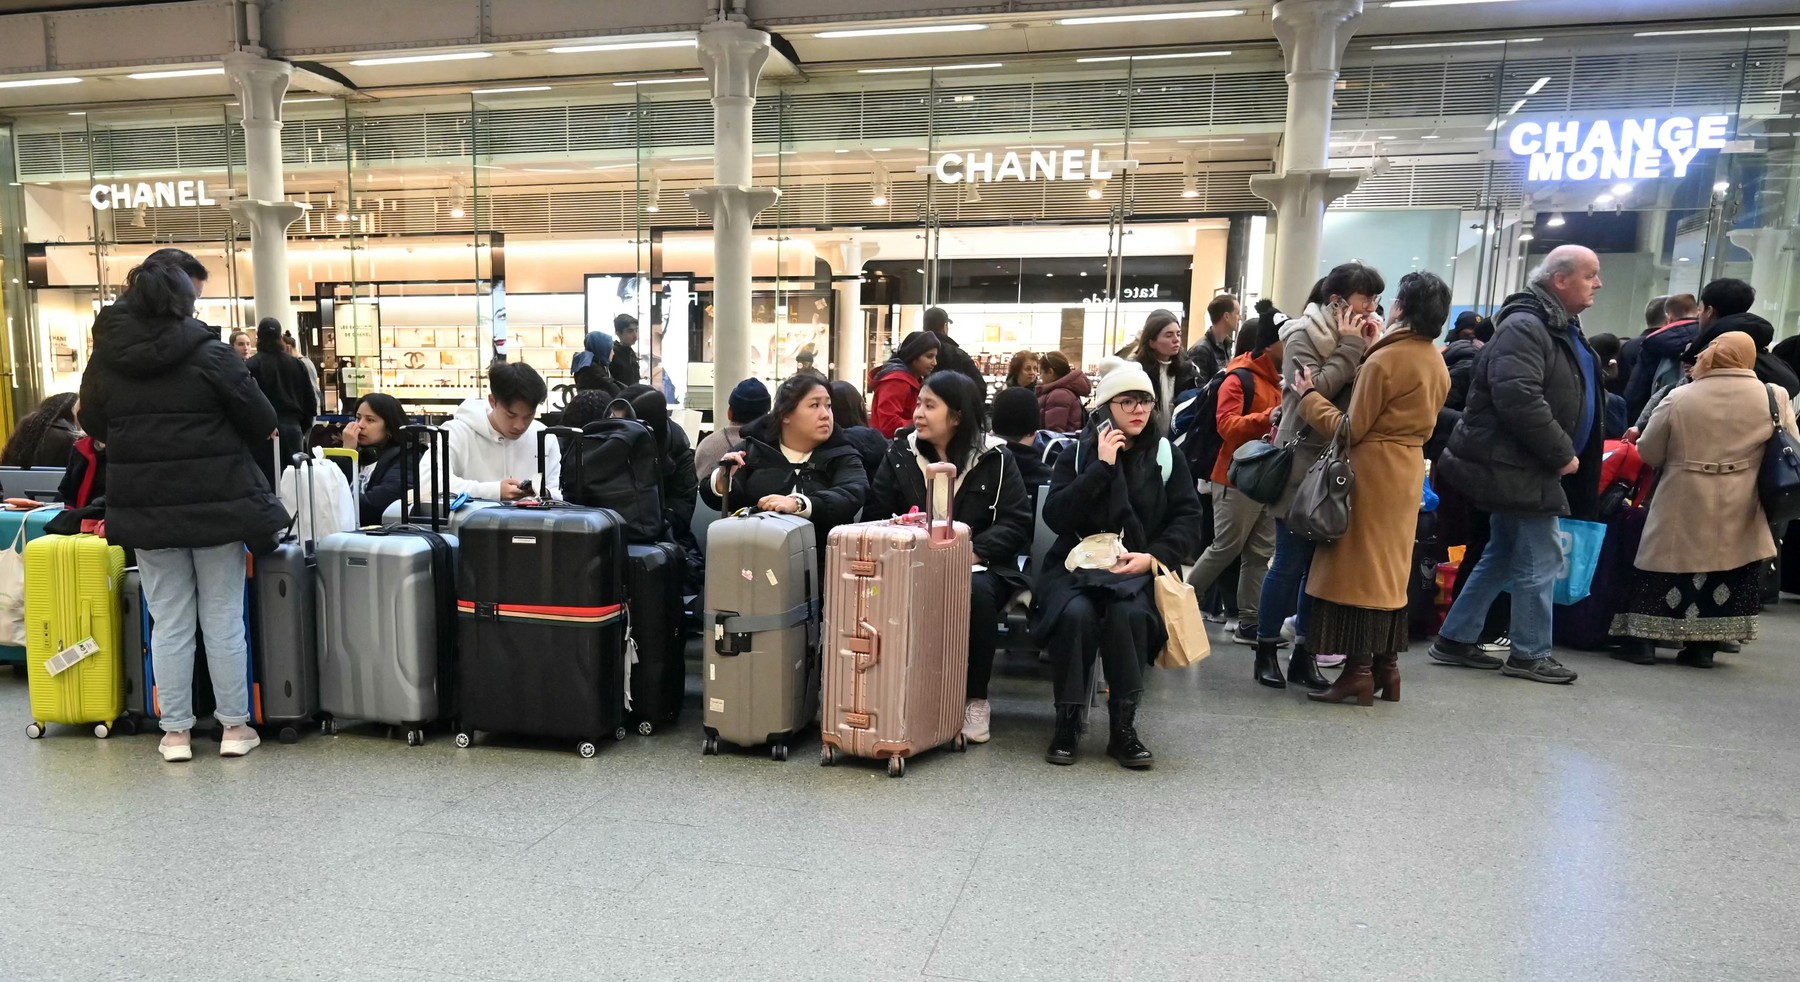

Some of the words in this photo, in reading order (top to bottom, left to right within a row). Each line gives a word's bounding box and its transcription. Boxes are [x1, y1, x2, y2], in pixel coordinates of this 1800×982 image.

[1509, 115, 1729, 156] CHANGE
[934, 149, 1113, 184] CHANEL
[1528, 147, 1700, 181] MONEY
[89, 180, 216, 210] CHANEL
